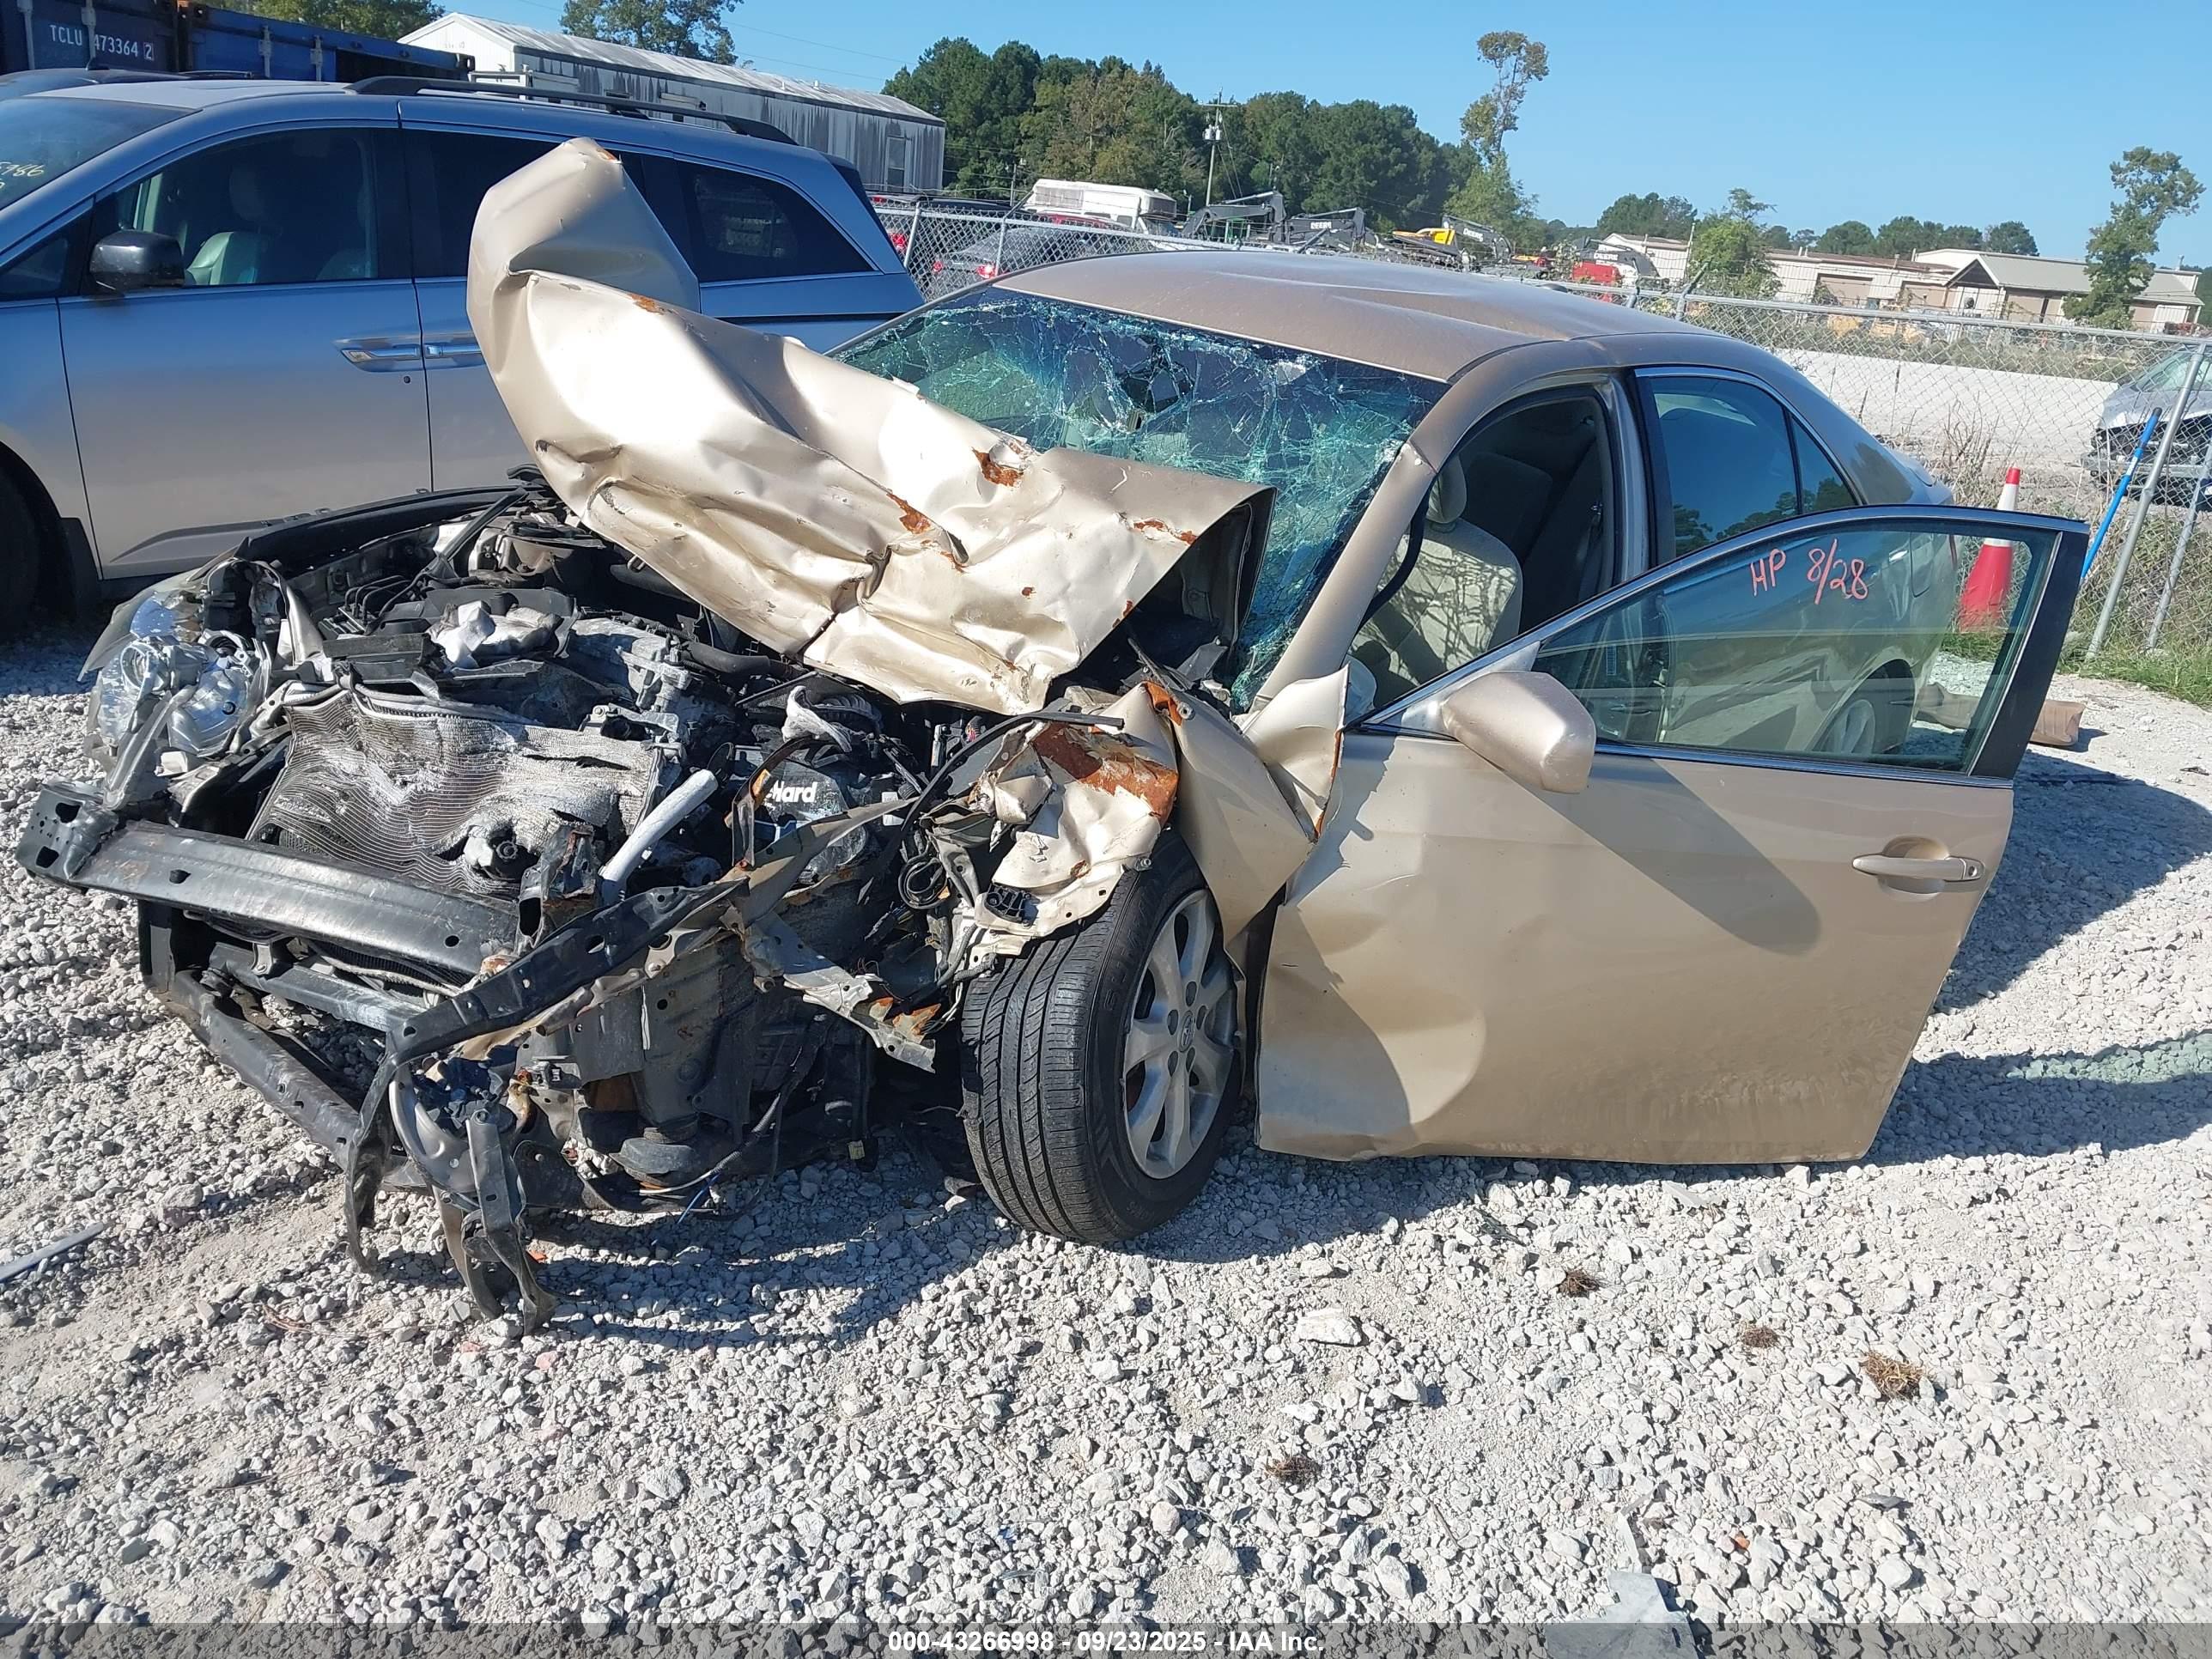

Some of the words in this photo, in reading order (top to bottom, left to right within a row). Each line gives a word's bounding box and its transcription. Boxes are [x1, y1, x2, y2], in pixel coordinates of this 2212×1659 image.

[50, 24, 83, 46] TCLU
[93, 33, 138, 58] 473364
[144, 43, 153, 60] 2
[1594, 252, 1619, 261] DEERE
[1750, 547, 1787, 597] HP
[1807, 538, 1869, 605] 8/28
